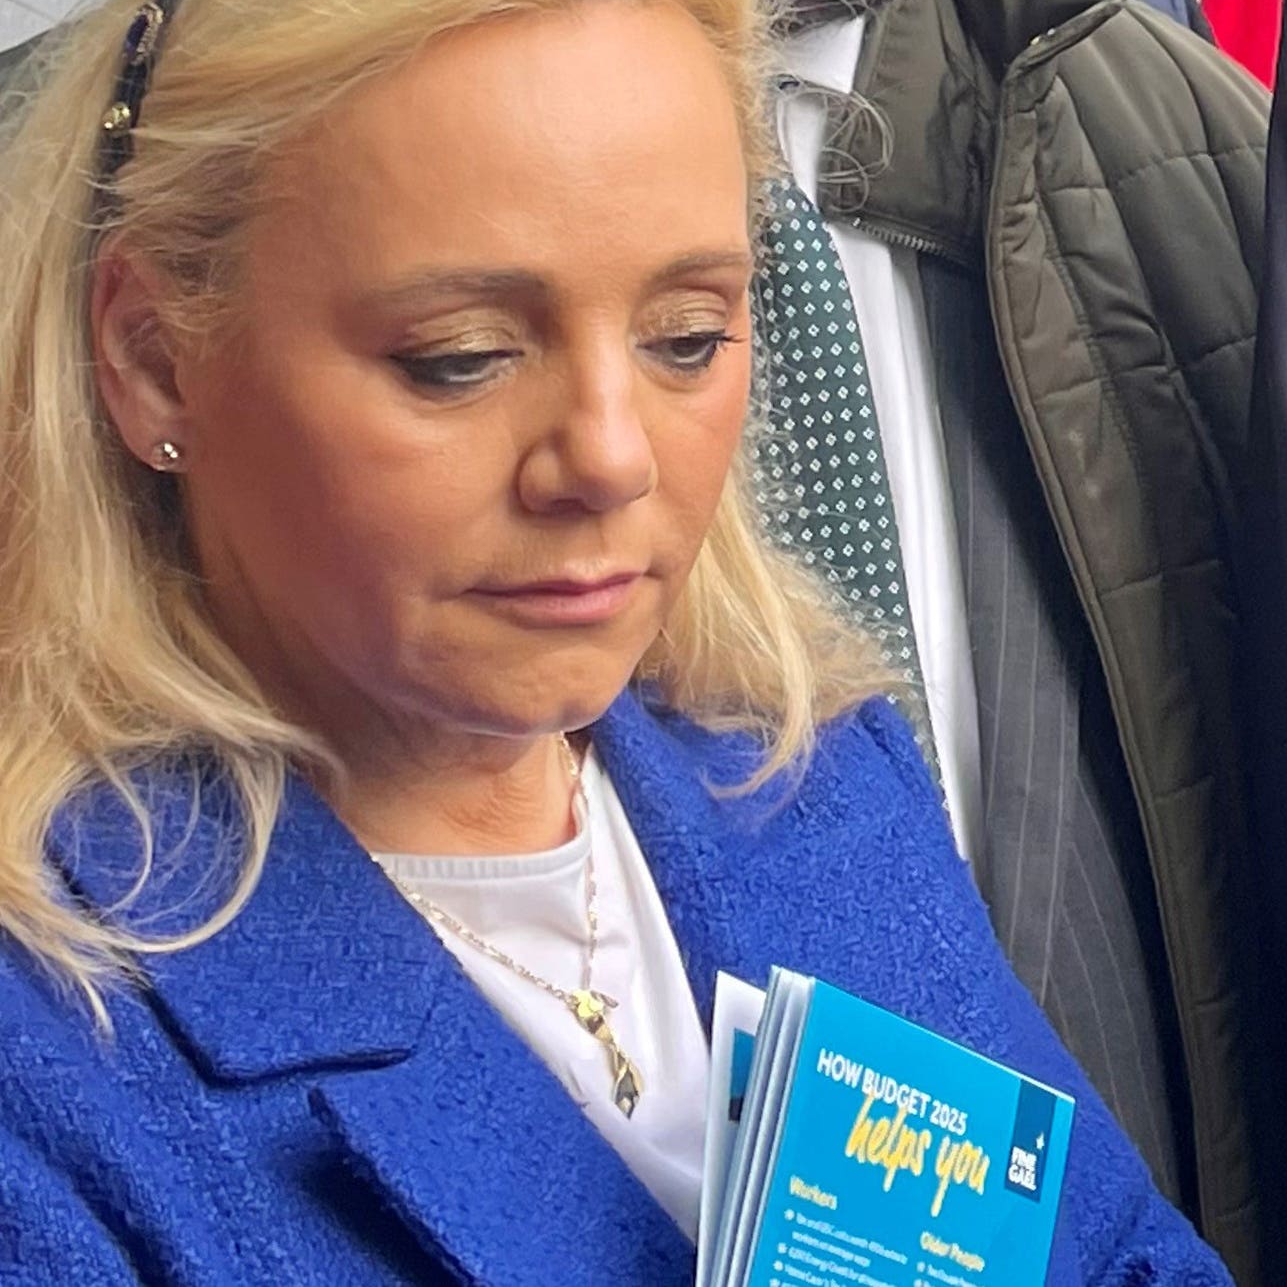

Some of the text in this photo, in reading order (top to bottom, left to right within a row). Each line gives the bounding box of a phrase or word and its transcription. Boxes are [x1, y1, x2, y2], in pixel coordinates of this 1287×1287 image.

[816, 1047, 968, 1136] HOW BUDGET 2025
[845, 1092, 990, 1216] helps you
